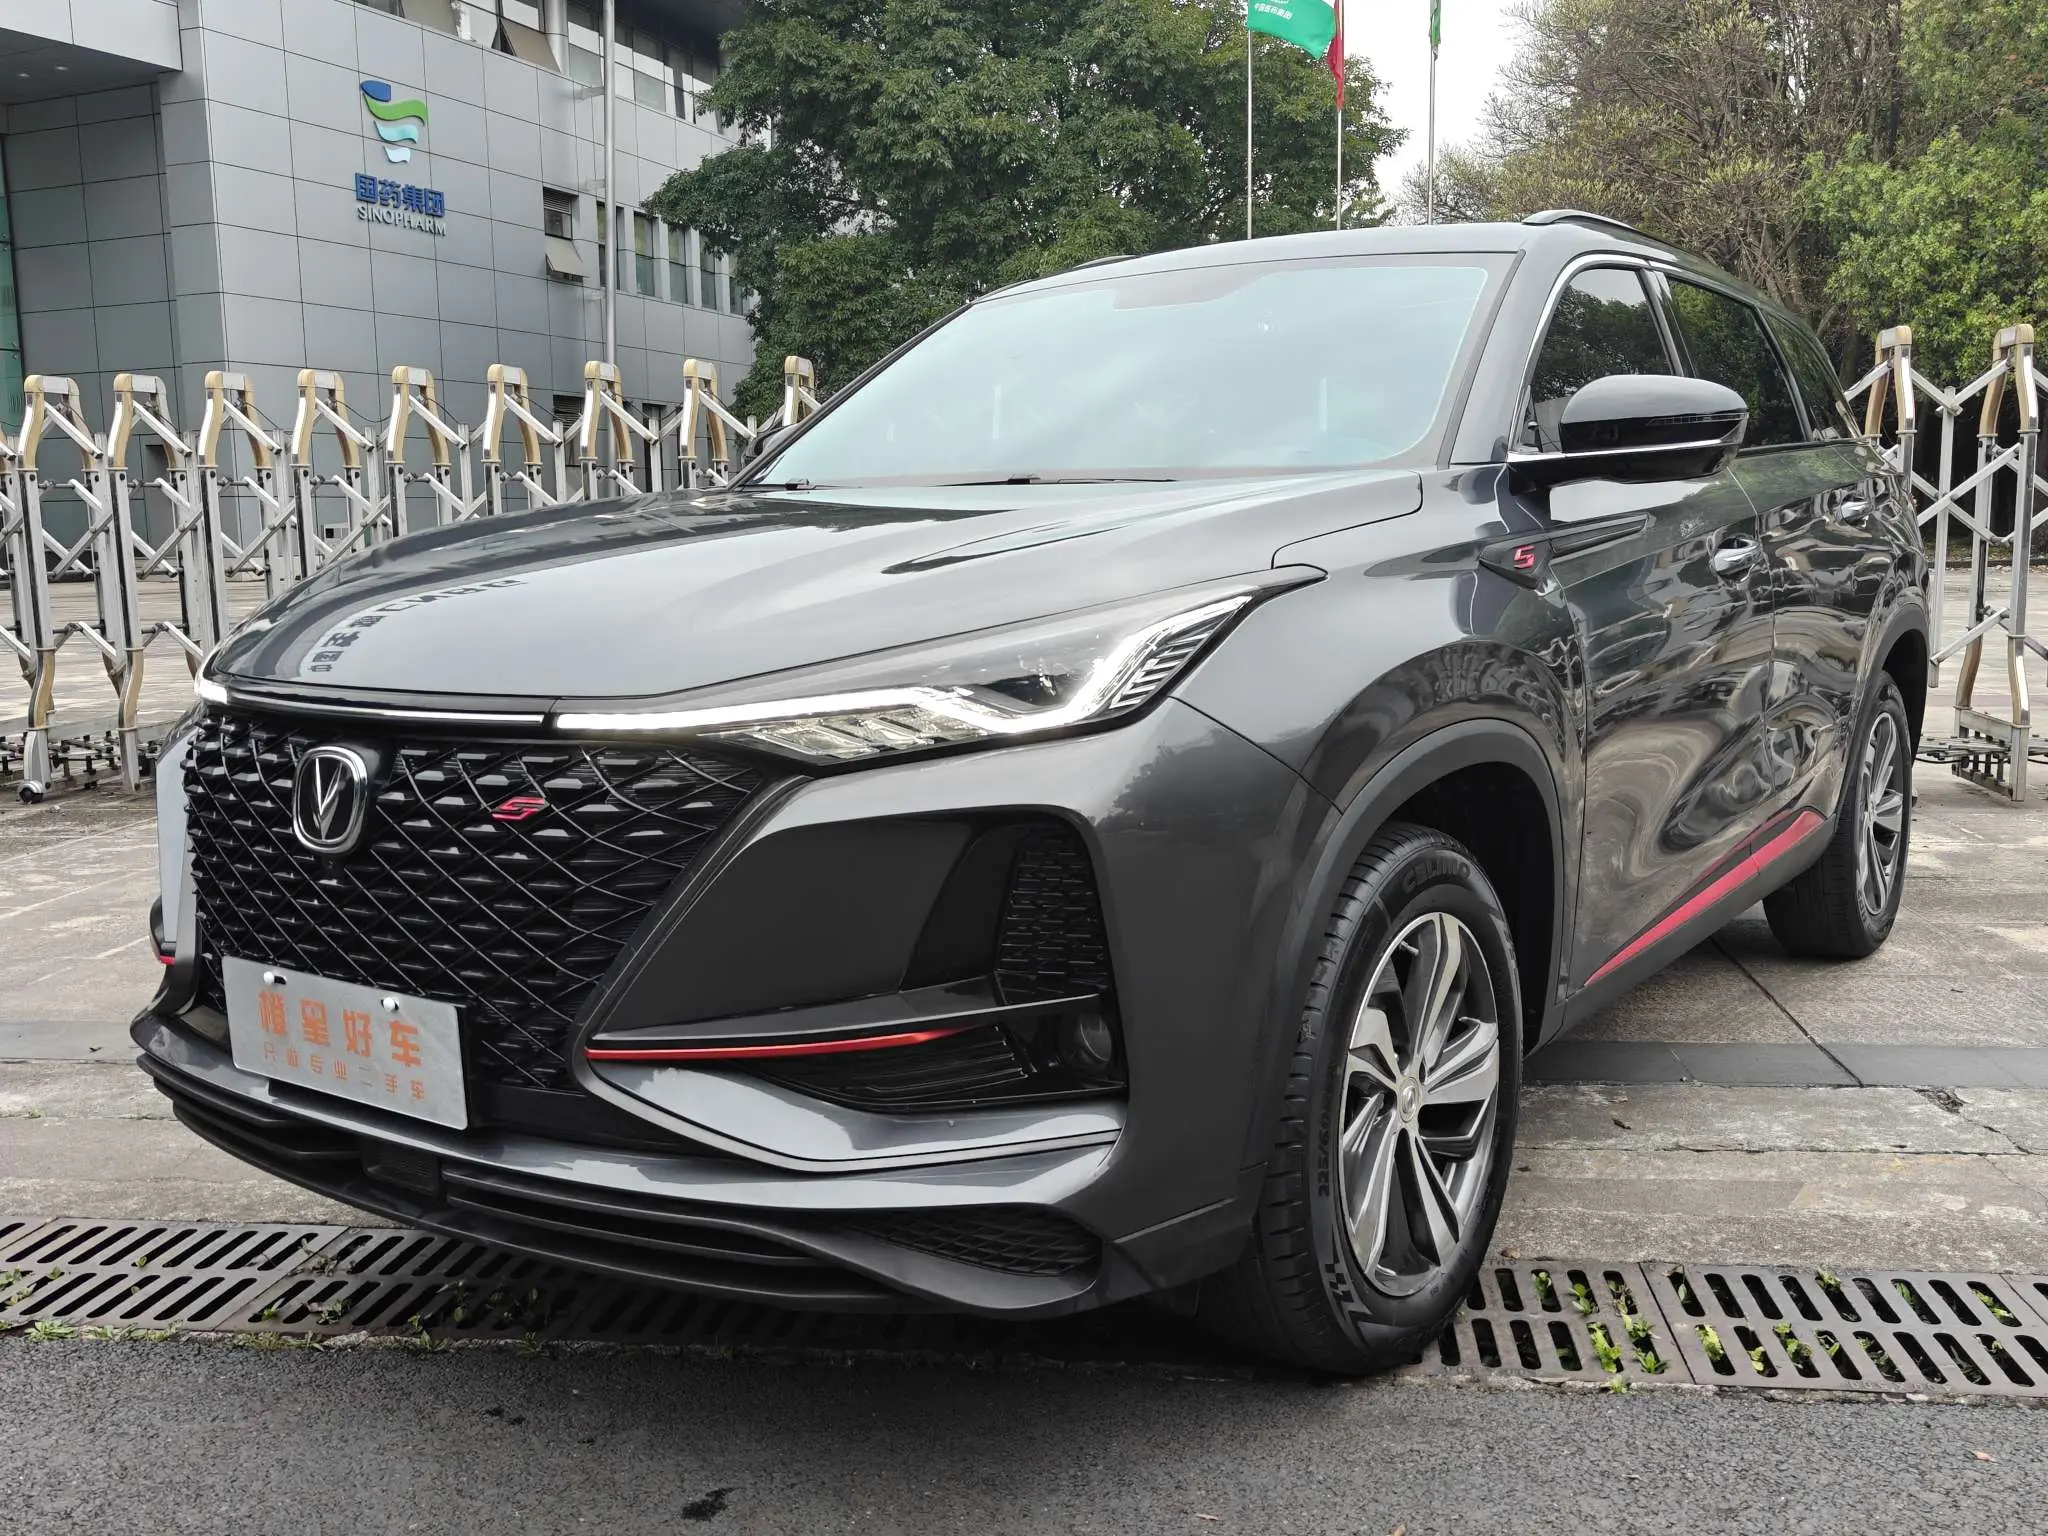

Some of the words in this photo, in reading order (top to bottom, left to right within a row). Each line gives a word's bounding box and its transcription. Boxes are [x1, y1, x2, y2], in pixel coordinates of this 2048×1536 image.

[355, 172, 445, 218] 国药集团
[358, 205, 447, 236] SINOPHARM
